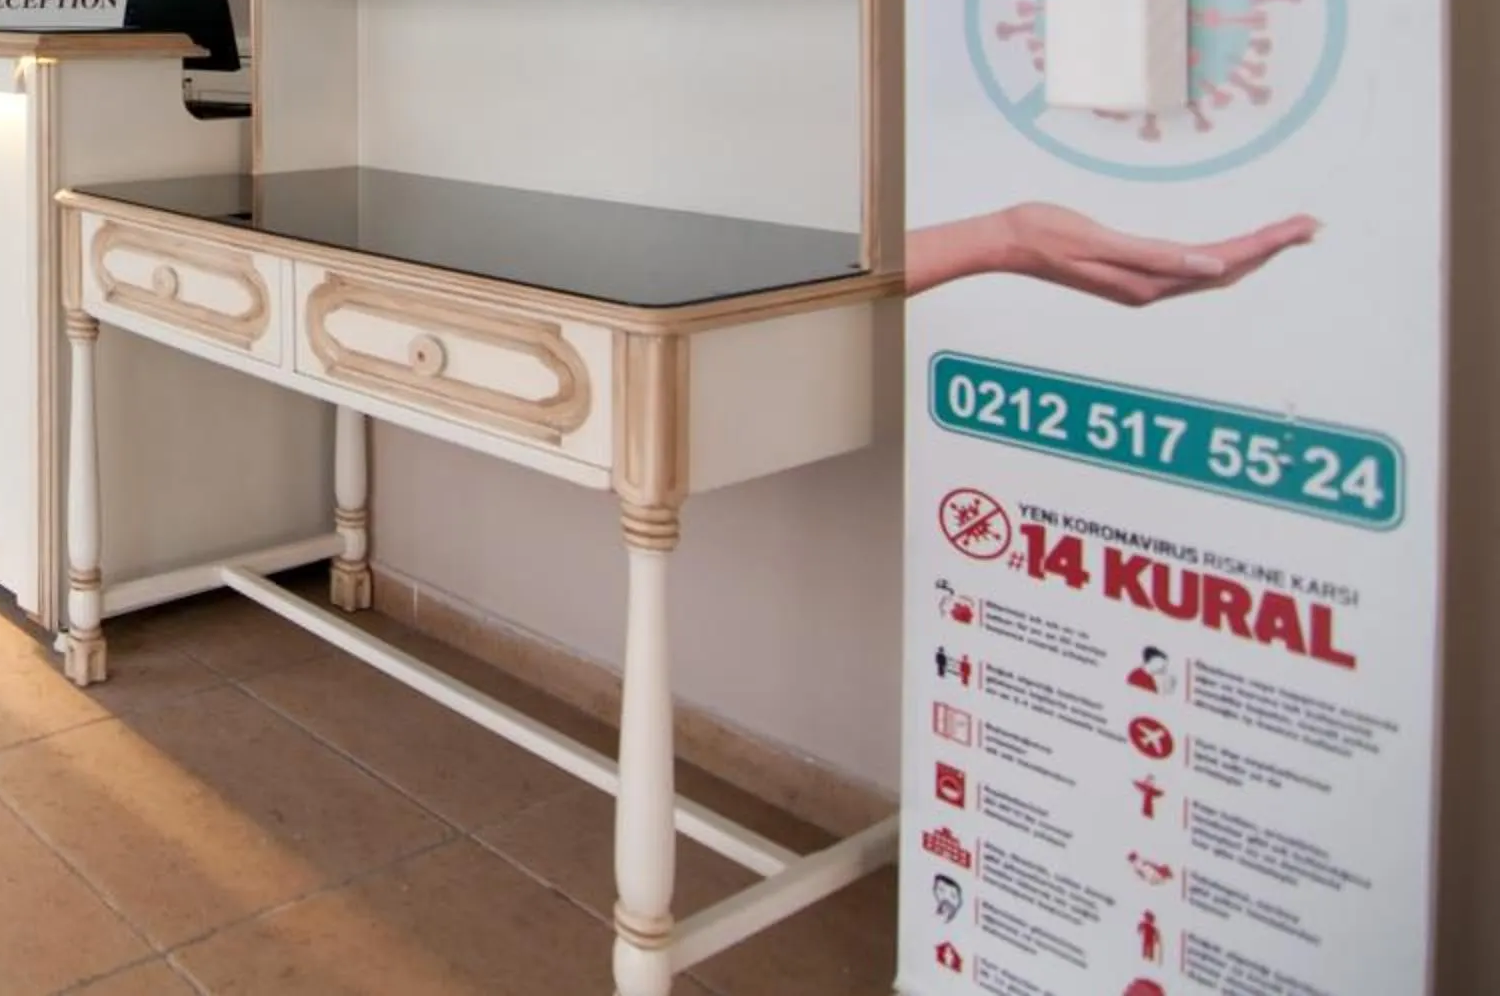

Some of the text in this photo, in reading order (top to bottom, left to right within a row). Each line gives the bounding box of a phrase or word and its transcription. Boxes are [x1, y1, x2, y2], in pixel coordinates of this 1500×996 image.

[948, 374, 1069, 441] 0212
[1086, 401, 1188, 464] 517
[1301, 446, 1384, 509] 24
[1007, 522, 1090, 590] #14
[1103, 546, 1358, 671] KURAL
